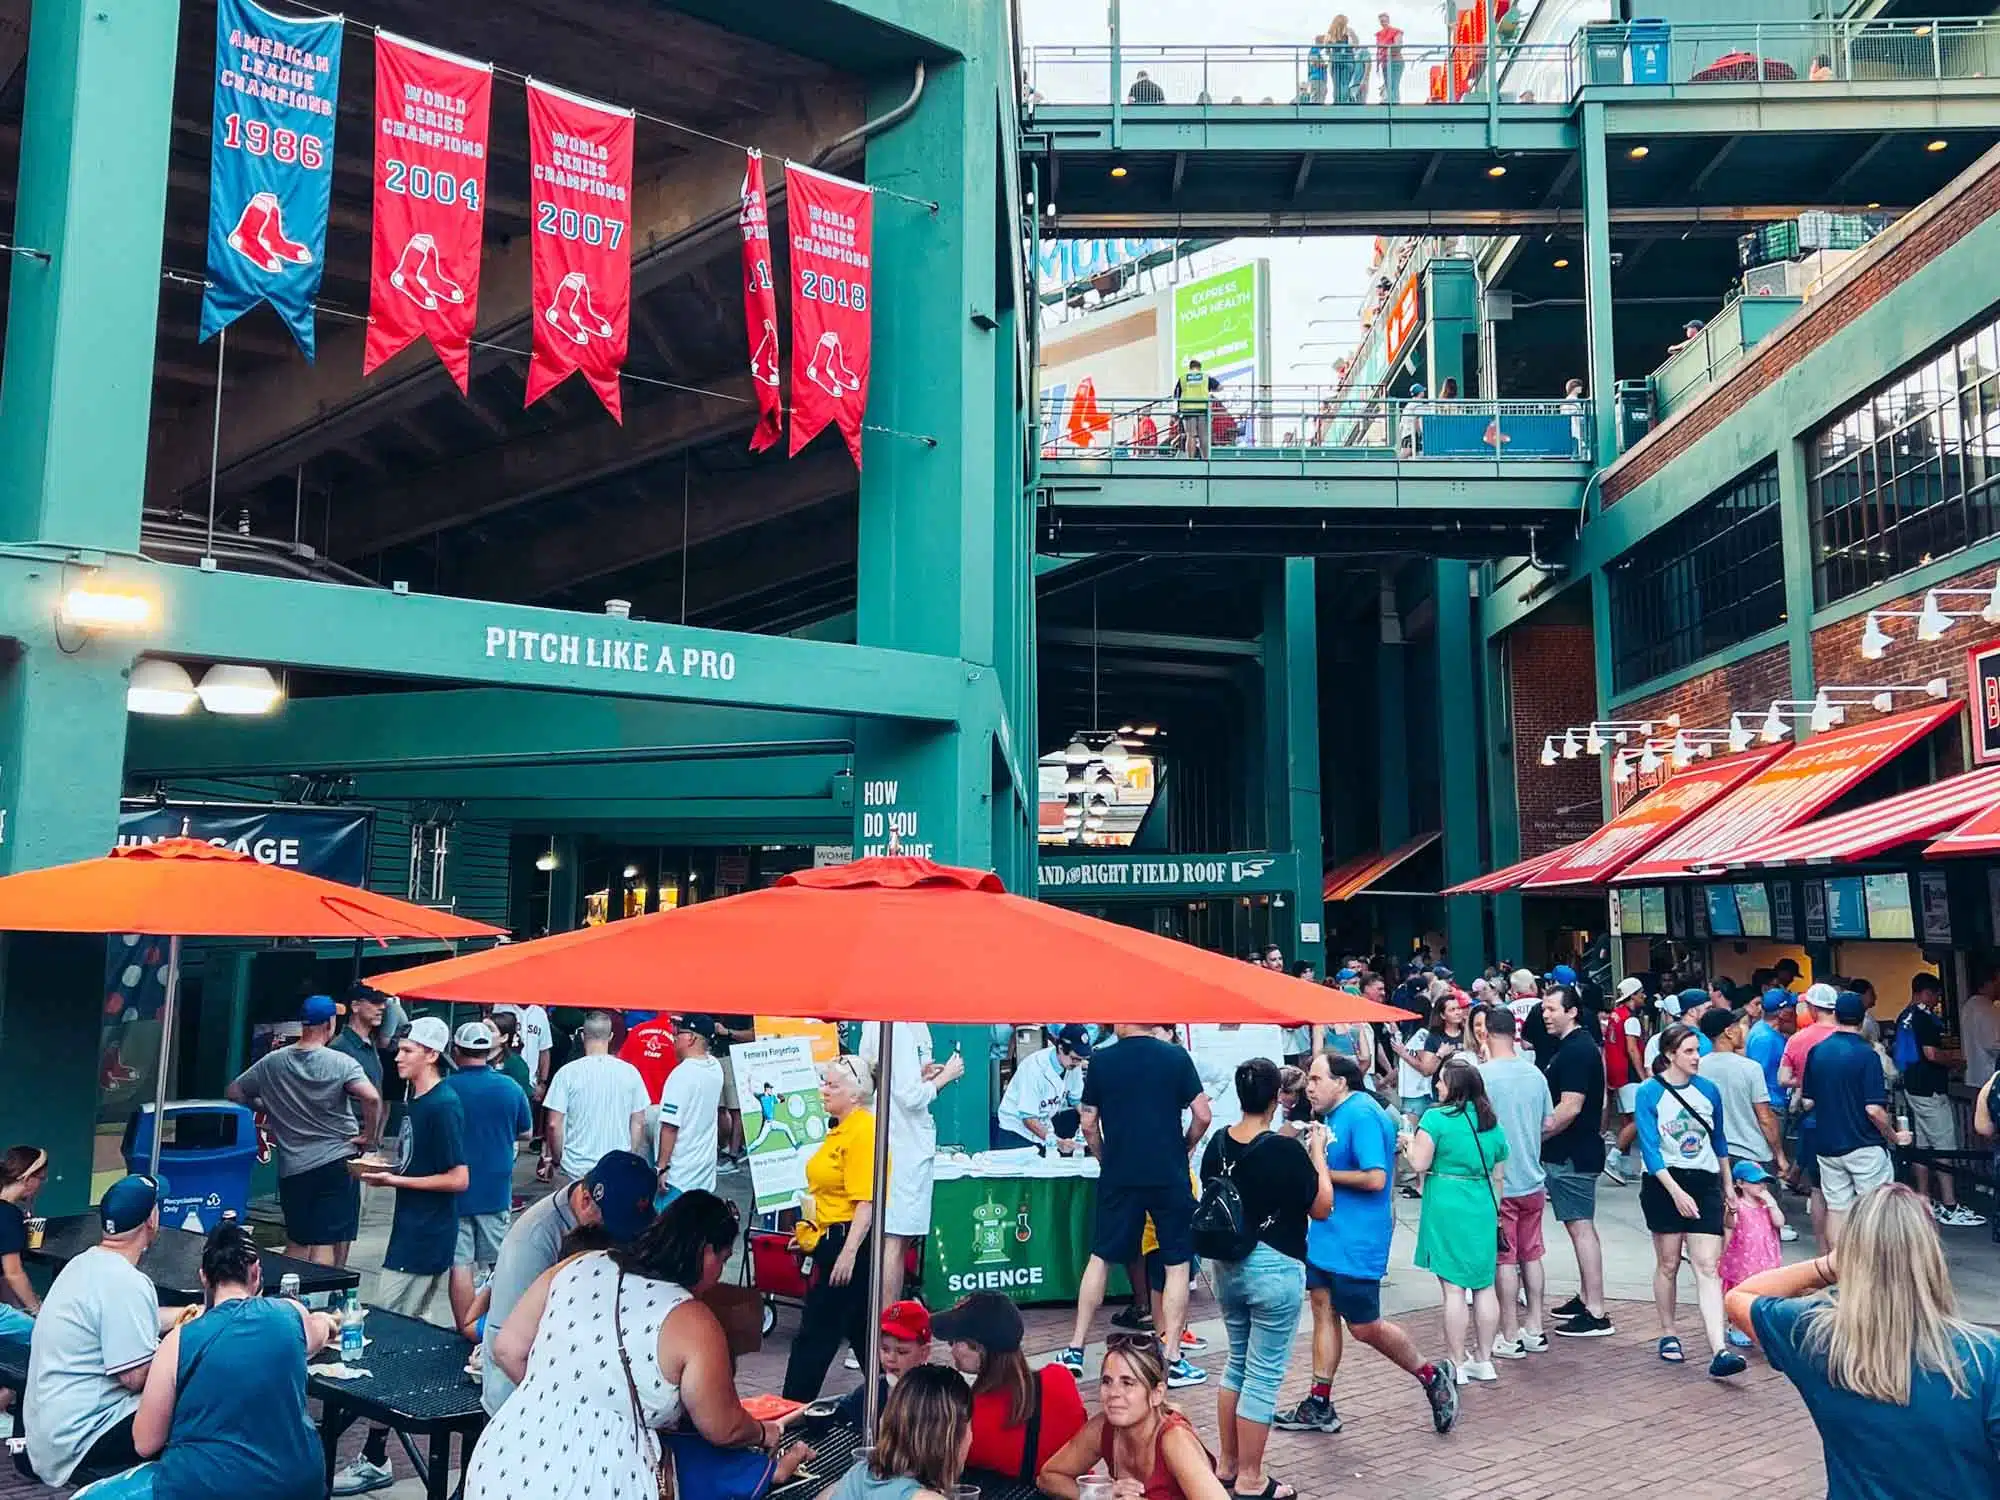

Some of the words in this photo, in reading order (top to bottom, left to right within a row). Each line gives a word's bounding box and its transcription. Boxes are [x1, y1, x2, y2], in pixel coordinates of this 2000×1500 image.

[229, 29, 329, 72] AMERICAN
[241, 54, 314, 91] LEAGUE
[221, 68, 332, 116] CHAMPIONS
[404, 83, 465, 114] WORLD
[405, 103, 464, 134] SERIES
[224, 113, 322, 169] 1986
[382, 118, 484, 159] CHAMPIONS
[552, 130, 608, 160] WORLD
[553, 150, 607, 178] SERIES
[385, 159, 479, 211] 2004
[534, 163, 626, 201] CHAMPIONS
[538, 201, 624, 250] 2007
[808, 204, 855, 230] WORLD
[811, 222, 855, 247] SERIES
[794, 235, 869, 268] CHAMPIONS
[802, 269, 866, 312] 2018
[1181, 305, 1208, 322] YOUR
[1209, 289, 1251, 313] HEALTH
[1192, 280, 1237, 304] EXPRESS
[485, 626, 580, 665] PITCH
[586, 637, 649, 672] LIKE
[655, 646, 677, 674] A
[683, 648, 736, 681] PRO
[864, 781, 898, 806] HOW
[863, 812, 883, 838] DO
[888, 811, 917, 837] YOU
[863, 844, 933, 860] MESURE
[1081, 864, 1129, 884] RIGHT
[1133, 862, 1180, 884] FIELD
[1183, 861, 1226, 882] ROOF
[743, 1050, 768, 1060] Fenway
[769, 1045, 800, 1057] Fingertips
[163, 1206, 179, 1214] Only
[948, 1267, 1043, 1291] SCIENCE
